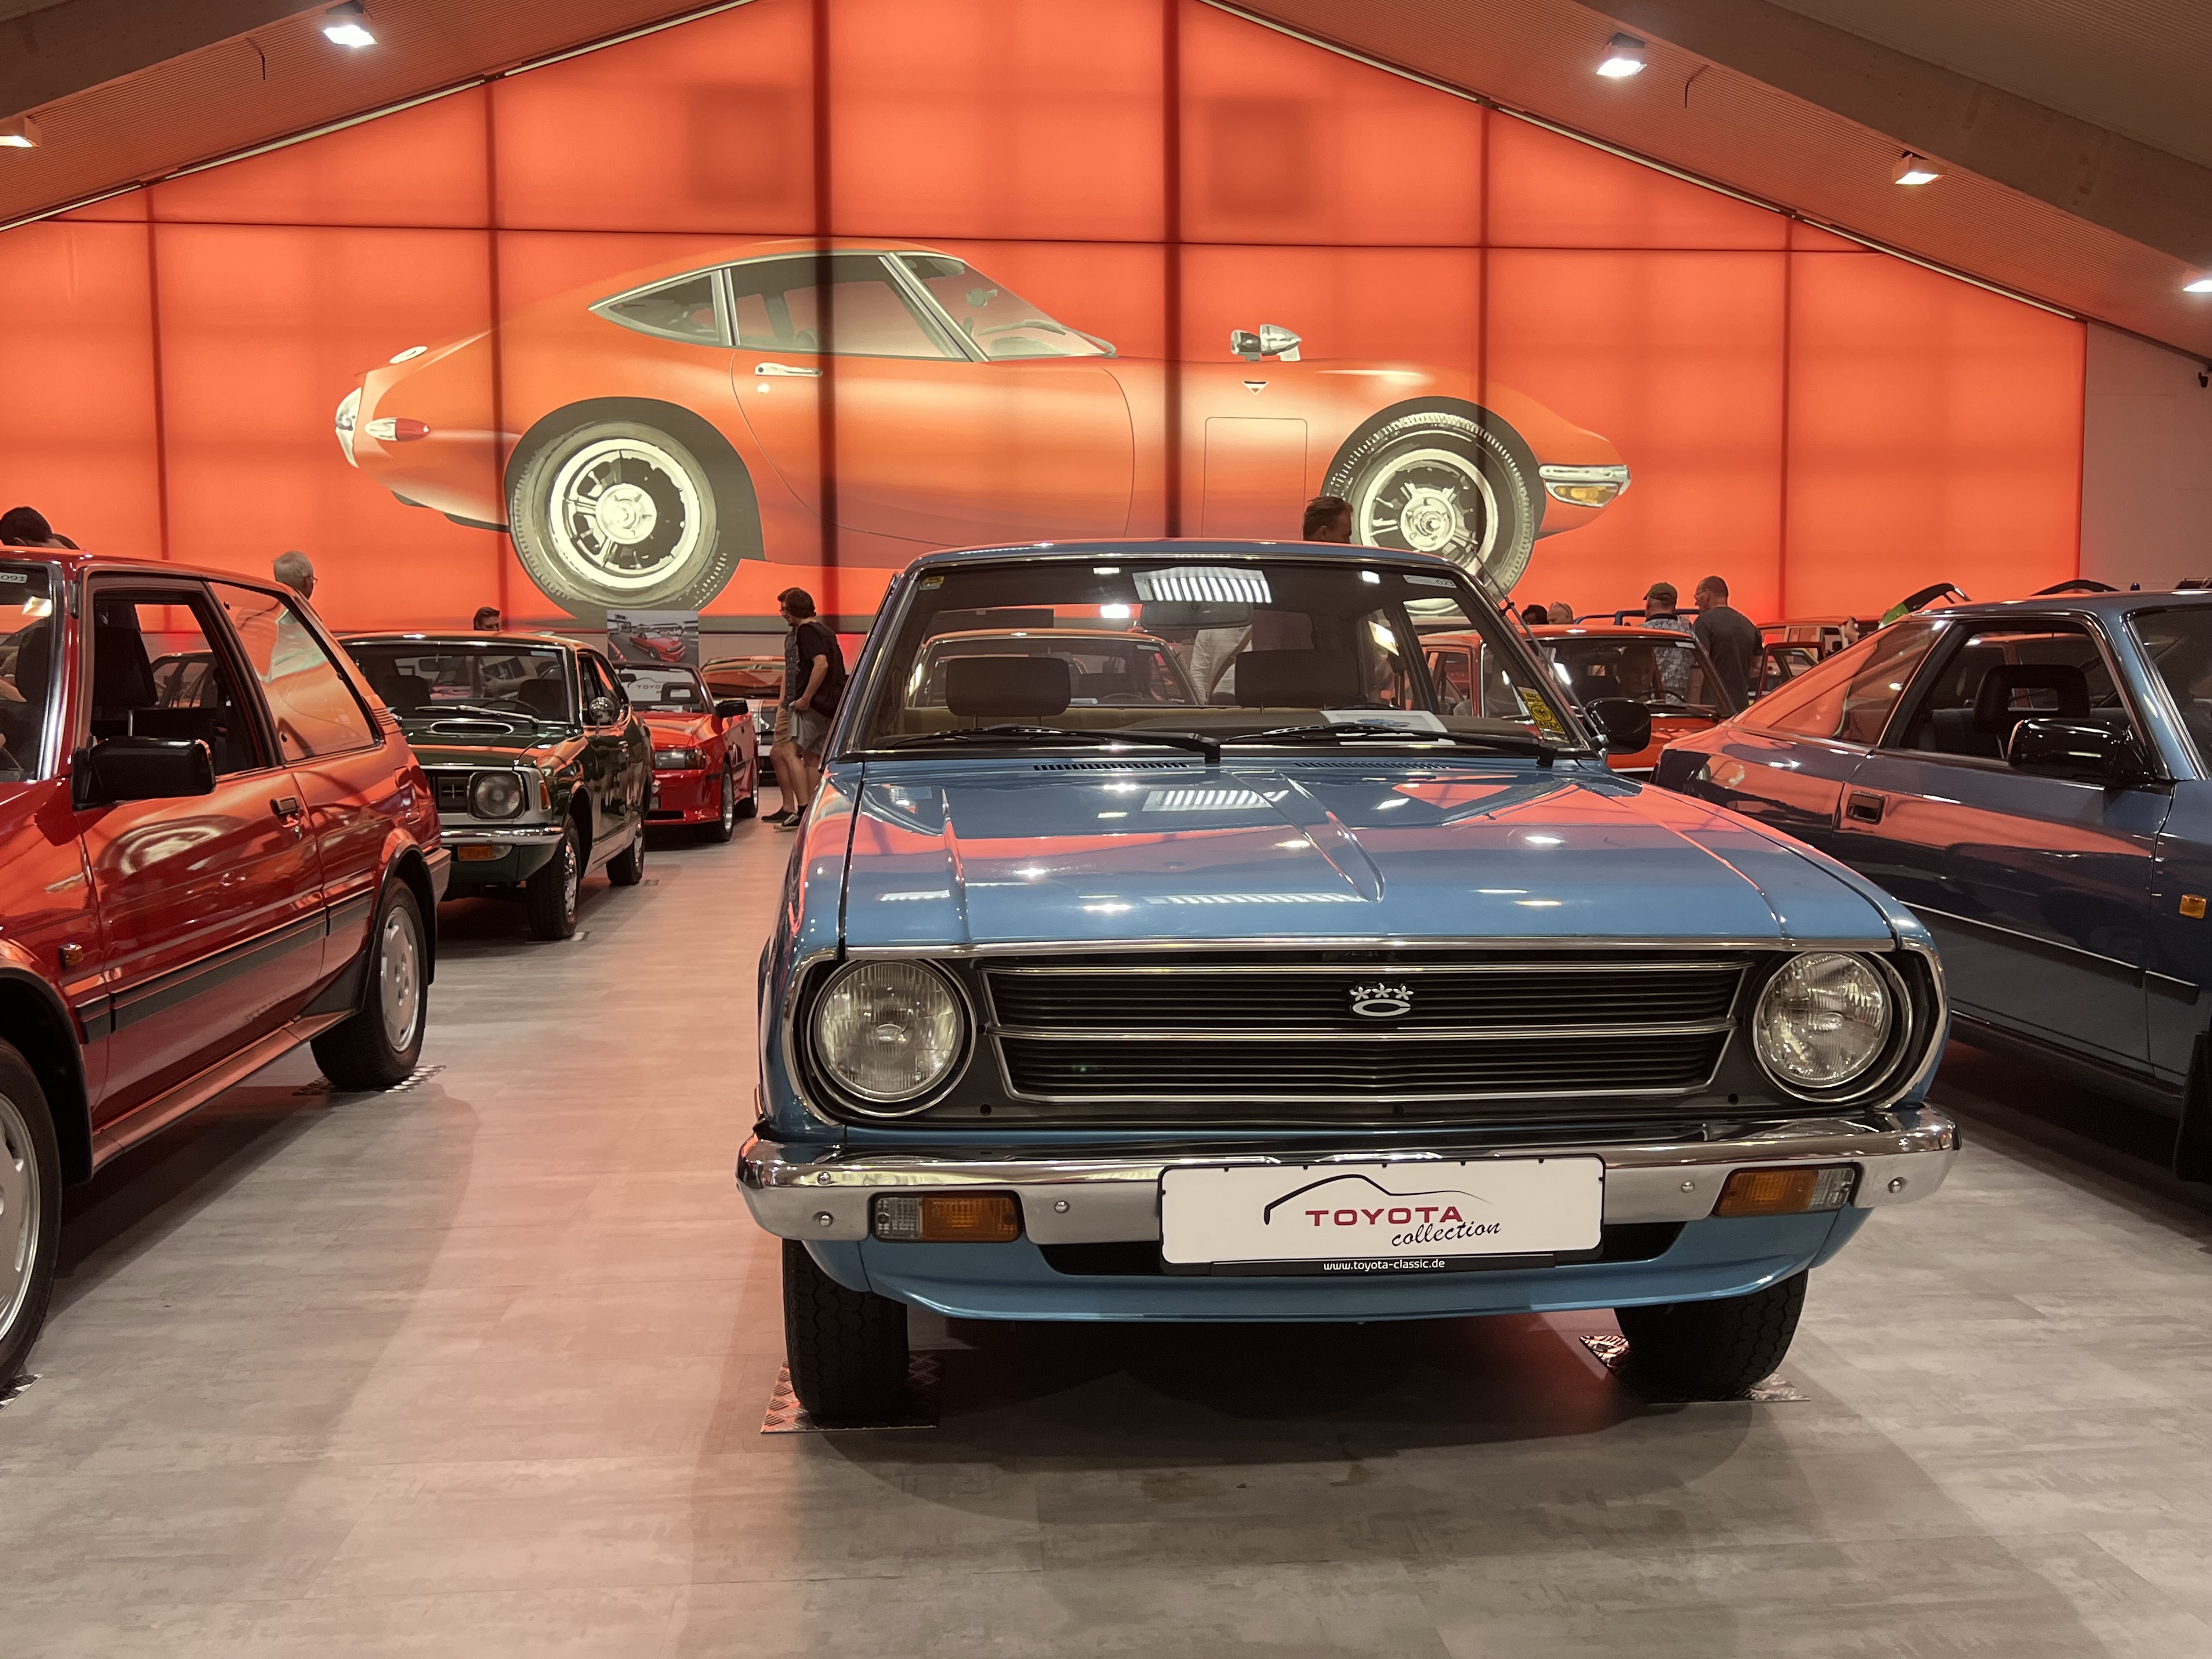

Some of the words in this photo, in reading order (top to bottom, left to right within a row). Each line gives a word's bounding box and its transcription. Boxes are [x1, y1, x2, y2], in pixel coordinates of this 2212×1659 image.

[1306, 1206, 1463, 1227] TOYOTA
[1391, 1221, 1501, 1248] collection
[1323, 1259, 1446, 1272] www.toyota-classic.de
